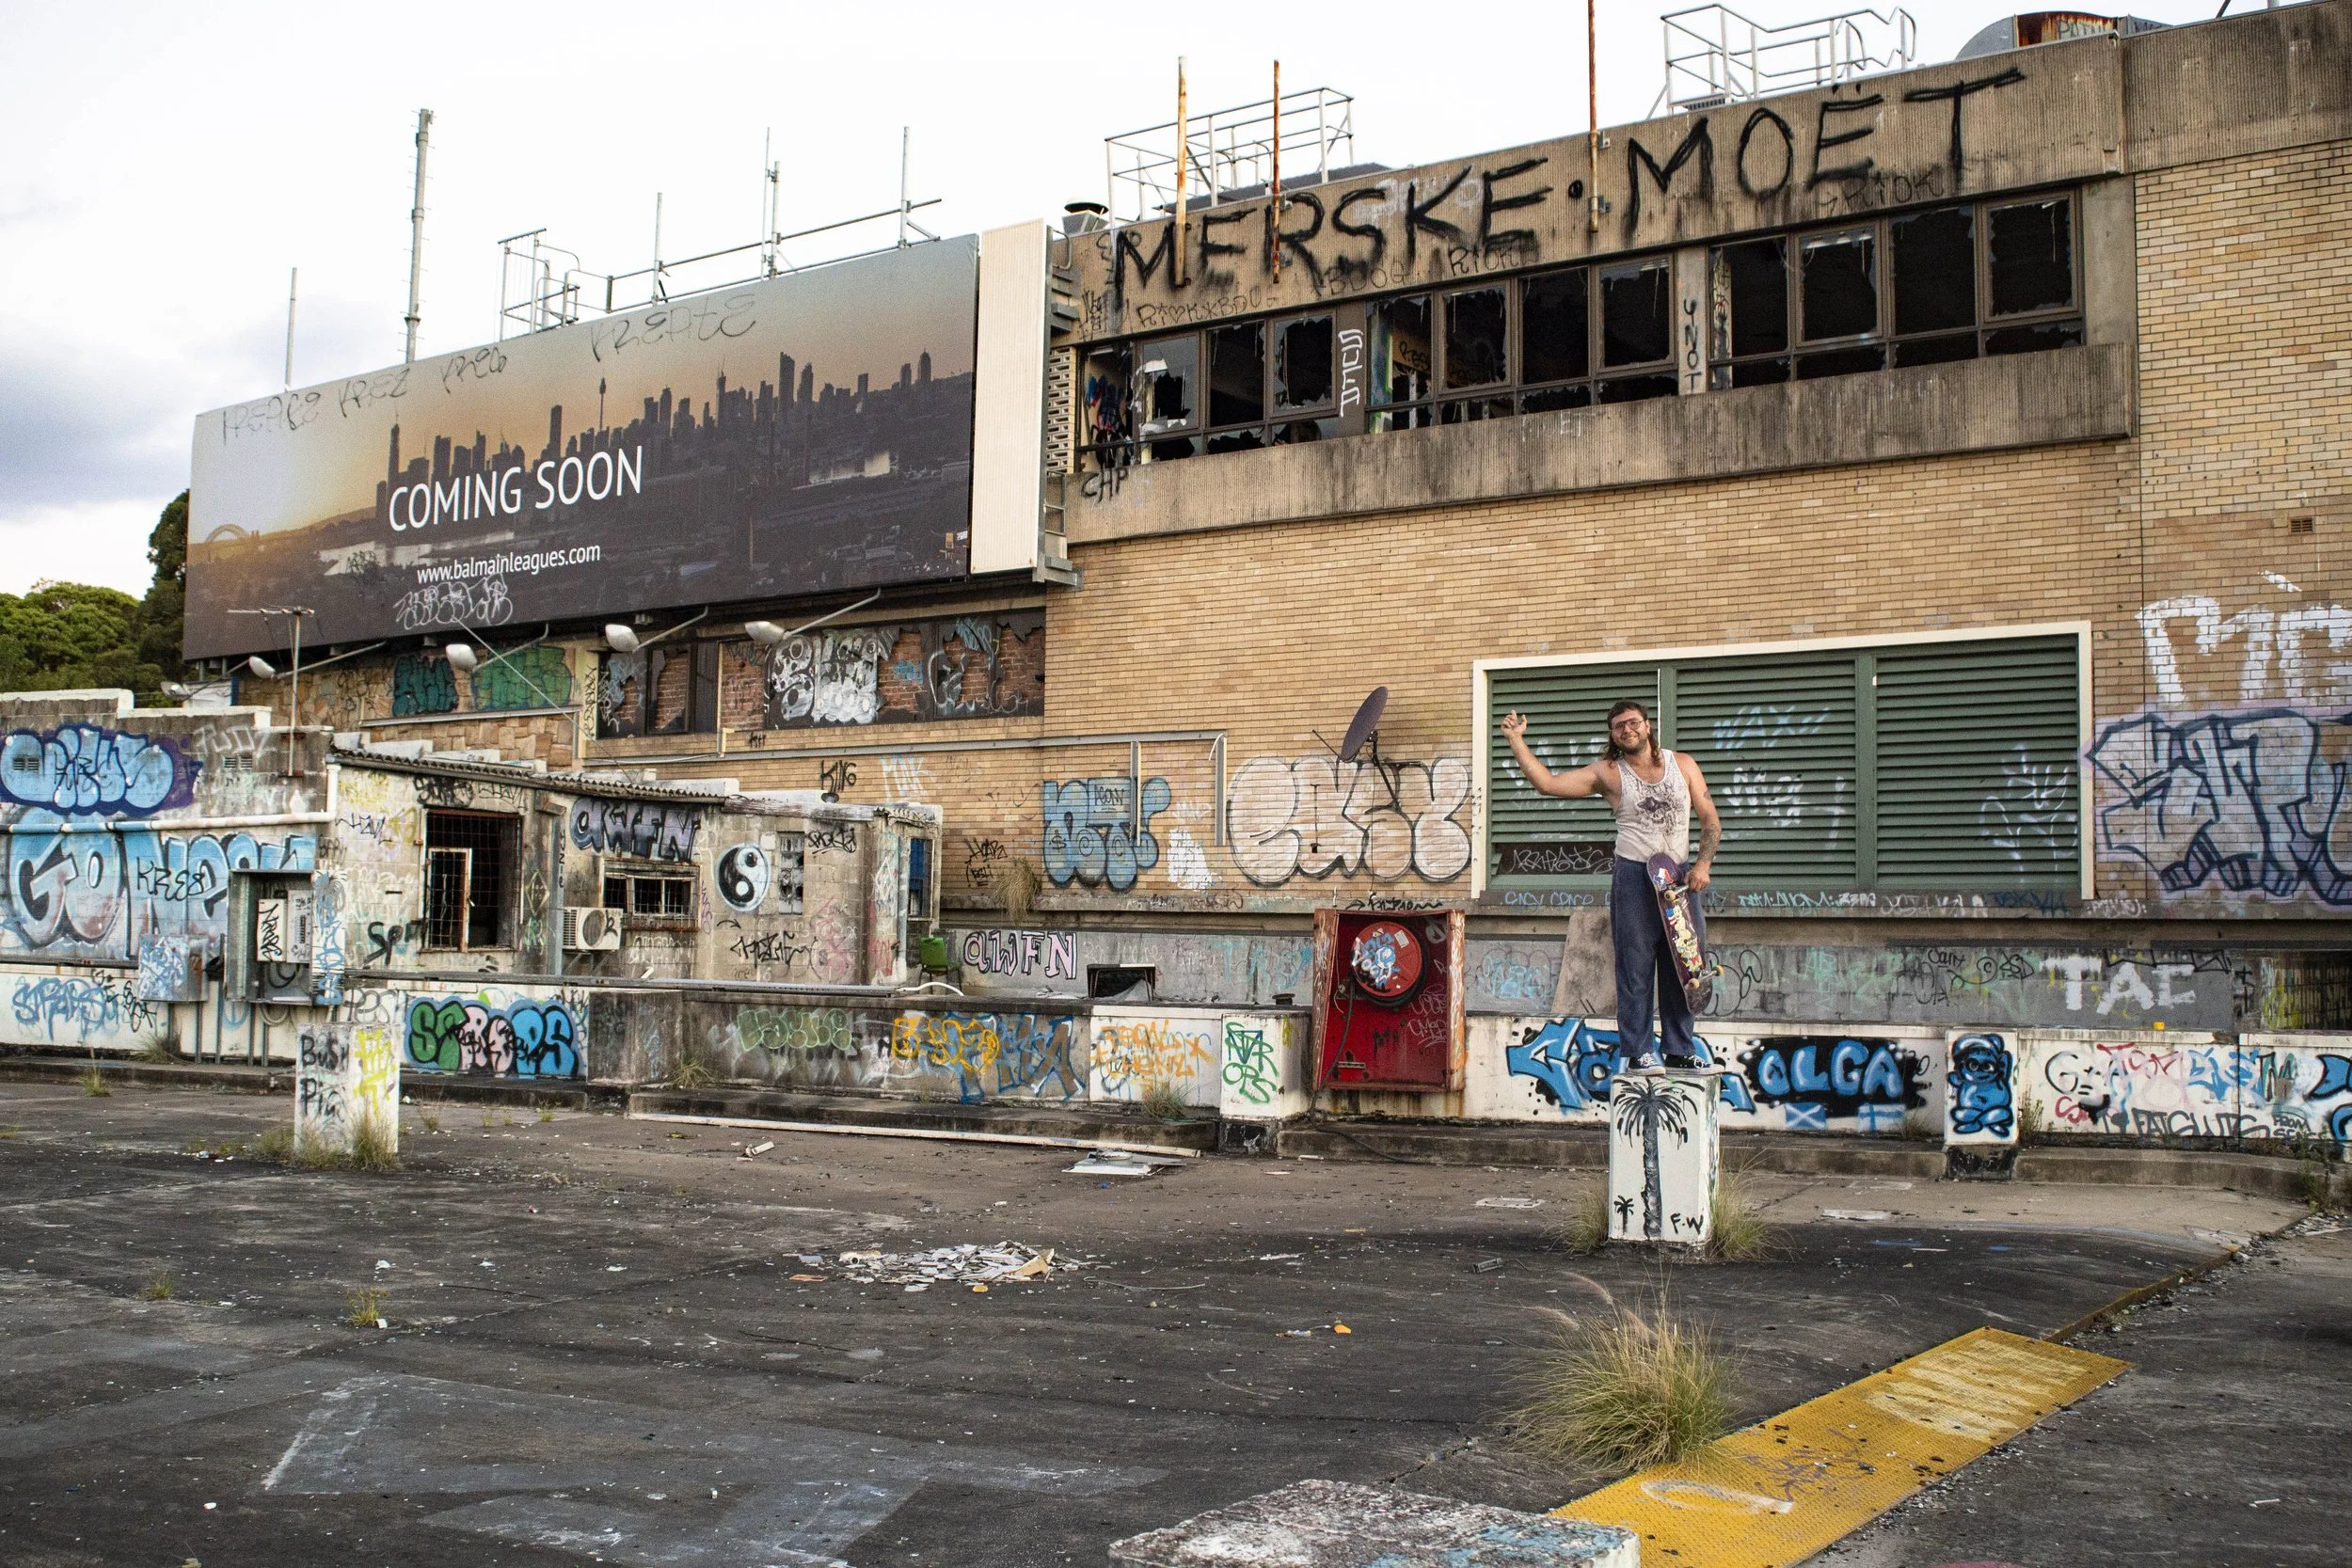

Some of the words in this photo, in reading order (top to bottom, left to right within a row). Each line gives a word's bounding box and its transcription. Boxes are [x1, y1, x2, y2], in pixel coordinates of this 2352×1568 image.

[1113, 158, 1554, 315] MERSKE
[389, 466, 522, 531] COMING
[534, 445, 644, 510] SOON
[417, 544, 601, 584] www.balmainleagues.com
[1757, 1039, 1904, 1100] OLGA
